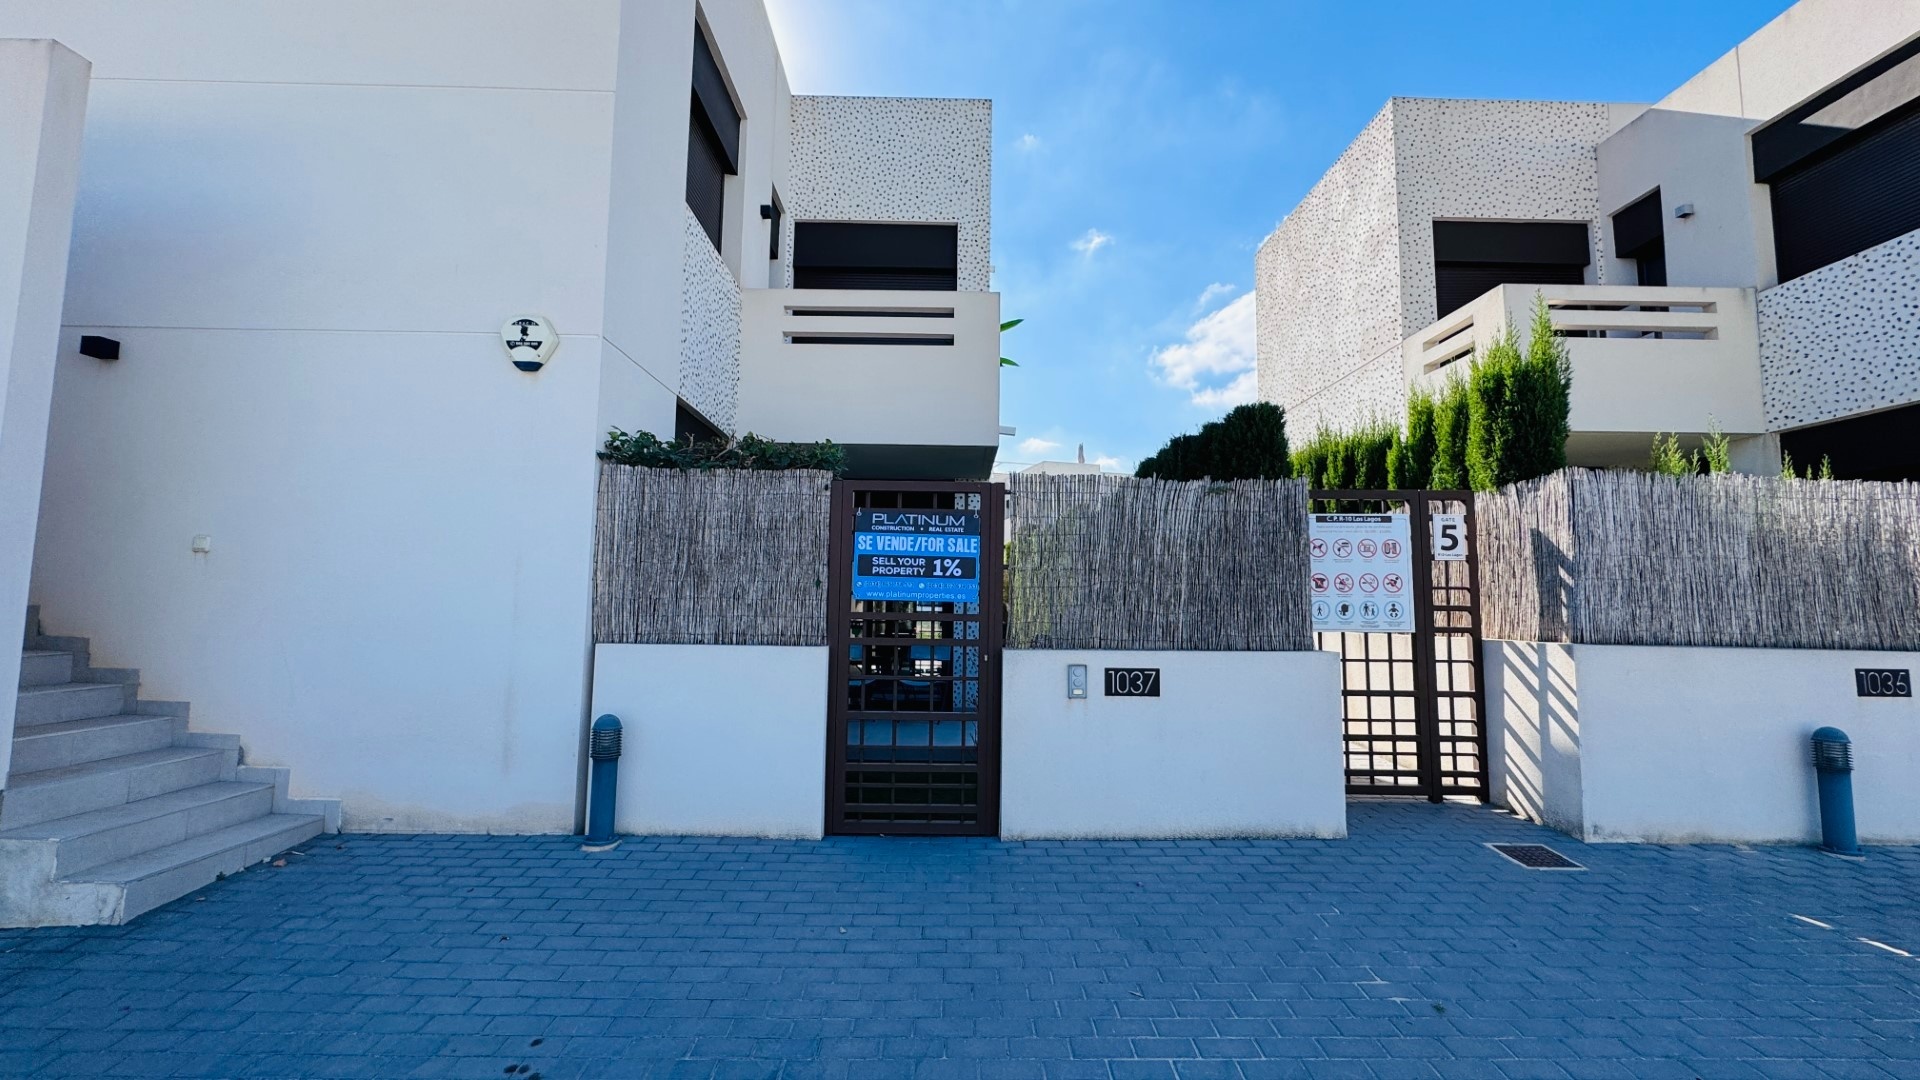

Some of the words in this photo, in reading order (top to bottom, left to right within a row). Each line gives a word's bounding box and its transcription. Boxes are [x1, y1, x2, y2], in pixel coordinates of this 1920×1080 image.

[872, 513, 965, 526] PLATINUM
[857, 535, 873, 550] SE
[876, 535, 944, 552] VENDE/FOR
[947, 538, 978, 553] SALE
[1440, 524, 1459, 552] 5
[872, 556, 896, 566] SELL
[897, 557, 926, 567] YOUR
[932, 558, 962, 577] 1%
[872, 566, 926, 576] PROPERTY
[866, 590, 966, 600] www.platinumproperties.es
[1108, 670, 1156, 694] 1037
[1859, 671, 1908, 695] 1035
